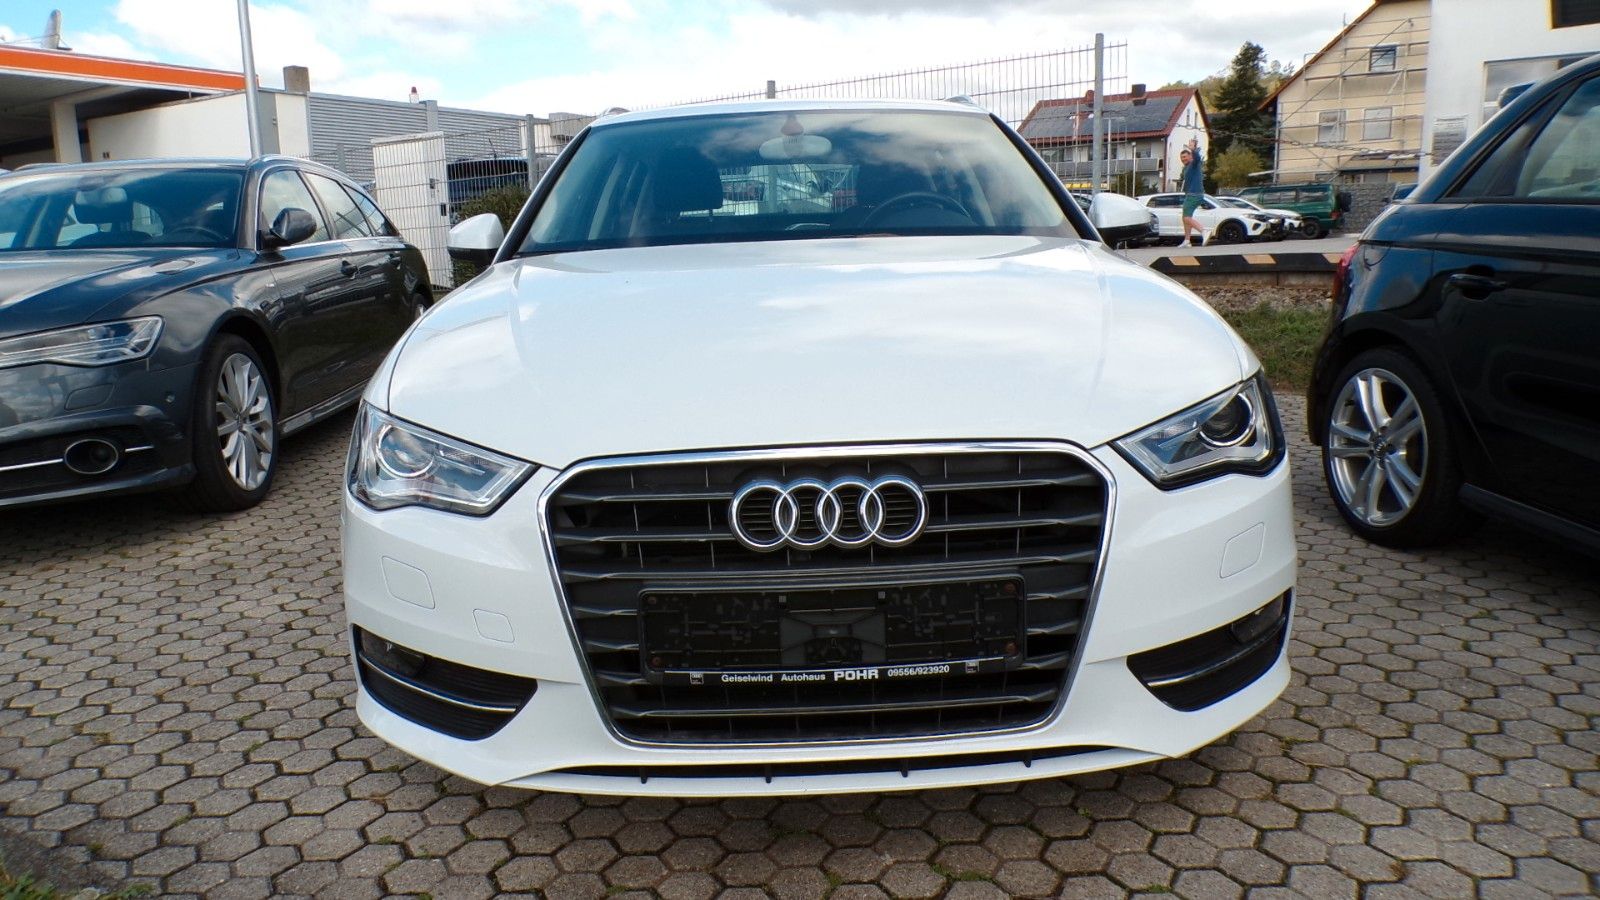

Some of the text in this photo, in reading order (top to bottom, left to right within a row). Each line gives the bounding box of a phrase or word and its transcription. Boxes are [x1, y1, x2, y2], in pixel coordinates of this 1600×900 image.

[720, 665, 951, 683] Geiselwind Autohaus POHR 09556/923920
